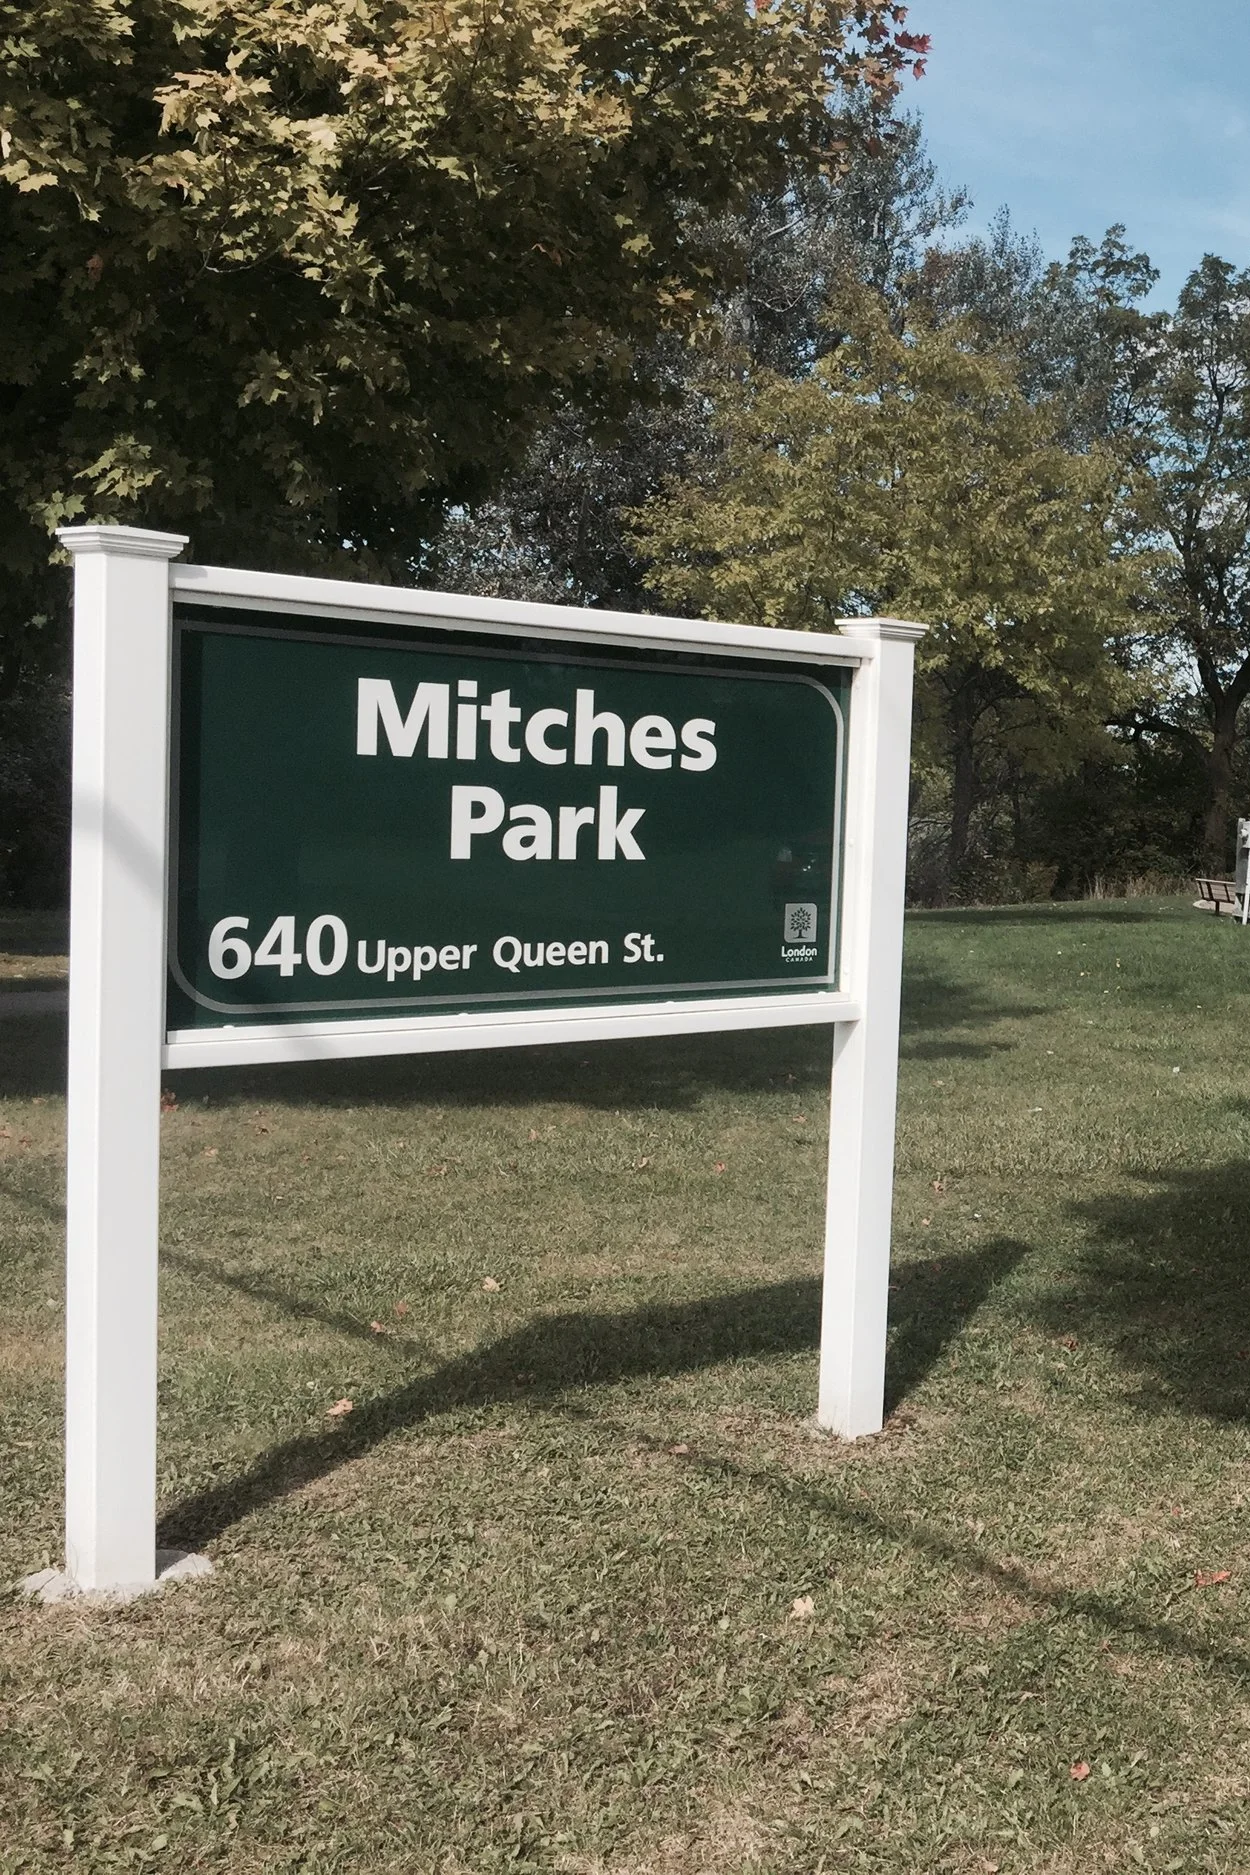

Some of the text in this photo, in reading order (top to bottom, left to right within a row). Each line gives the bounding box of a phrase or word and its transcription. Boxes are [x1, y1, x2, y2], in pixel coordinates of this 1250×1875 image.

[356, 677, 718, 772] Mitches
[449, 785, 646, 861] Park
[207, 914, 665, 981] 640 Upper Queen St.
[781, 945, 818, 957] London
